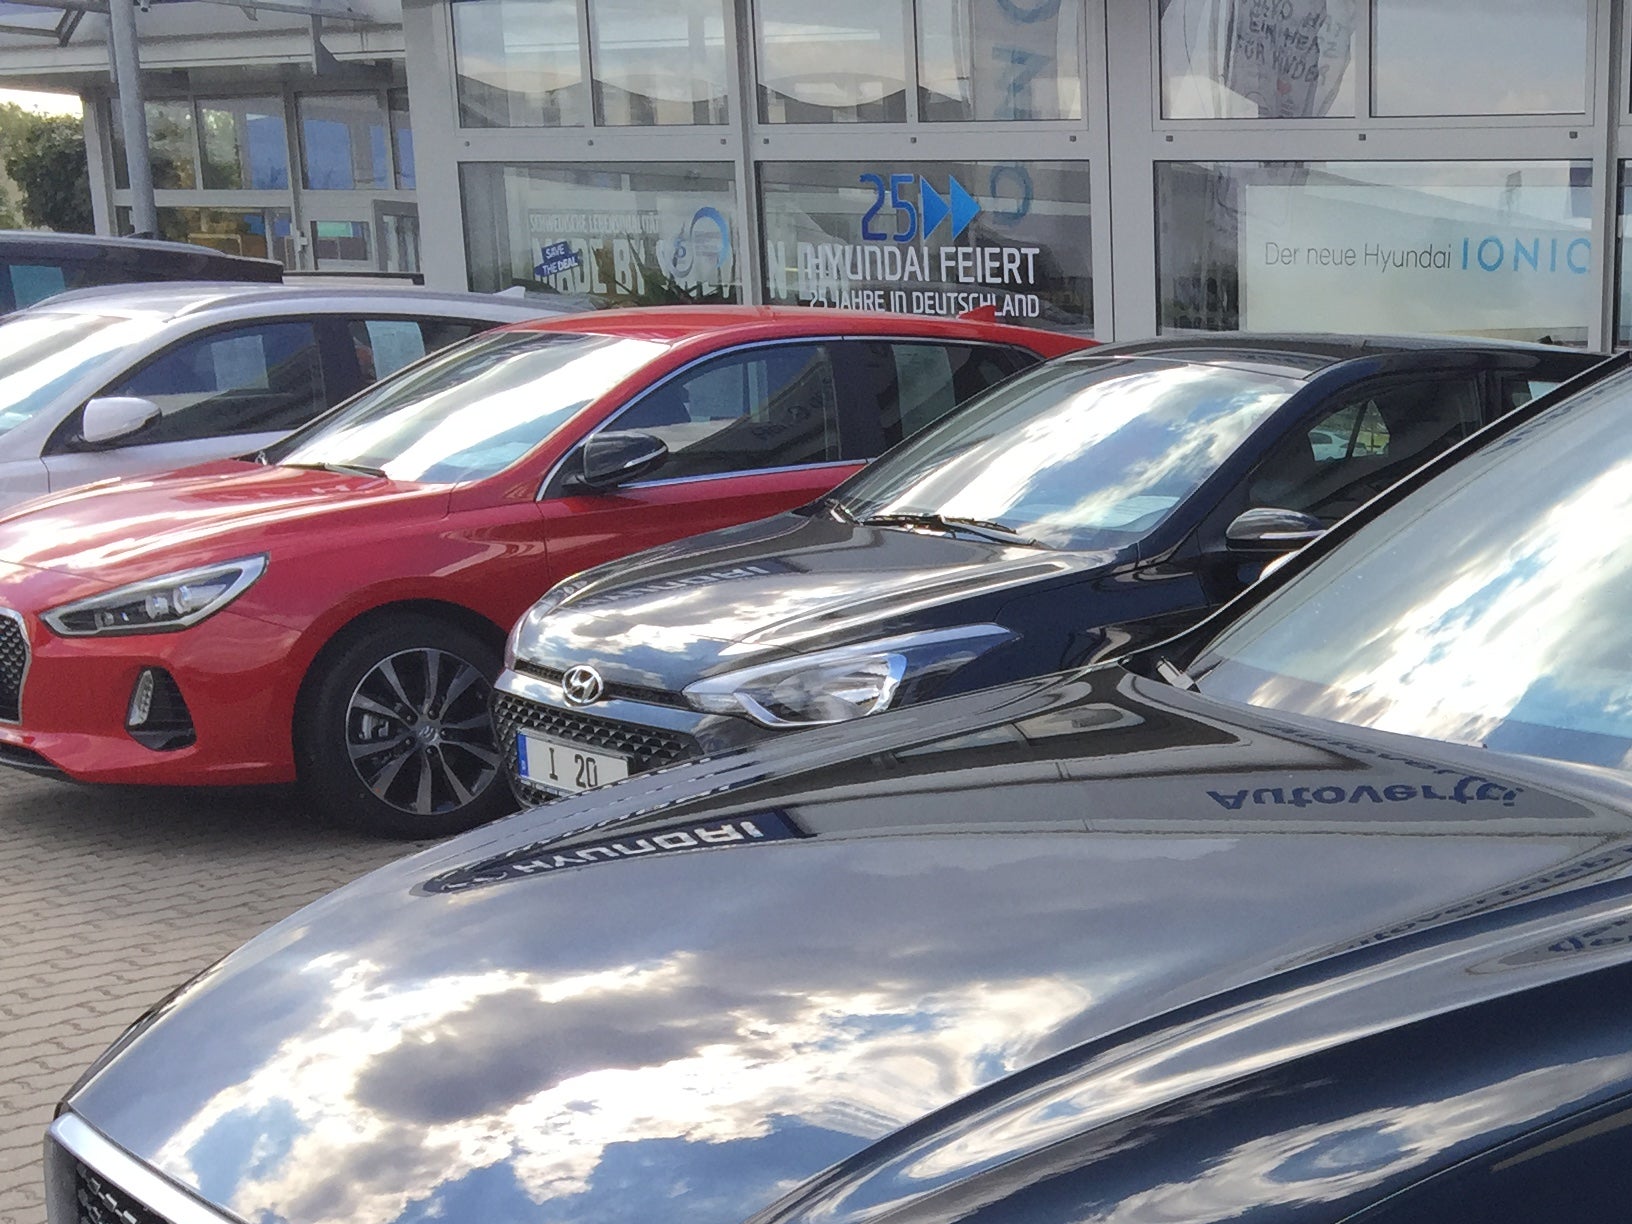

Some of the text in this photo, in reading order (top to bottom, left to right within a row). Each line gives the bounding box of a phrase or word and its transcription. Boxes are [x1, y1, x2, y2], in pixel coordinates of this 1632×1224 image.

[859, 173, 918, 244] 25
[542, 256, 578, 275] THE DEAL
[545, 243, 565, 260] SAVE
[807, 243, 931, 281] HYUNDAI
[940, 246, 1040, 284] FEIERT
[1265, 242, 1299, 265] Der
[1307, 246, 1356, 266] neue
[1364, 243, 1452, 273] Hyundai
[890, 291, 907, 313] IN
[912, 292, 1041, 318] DEUTSCHLAND
[574, 753, 599, 788] 20
